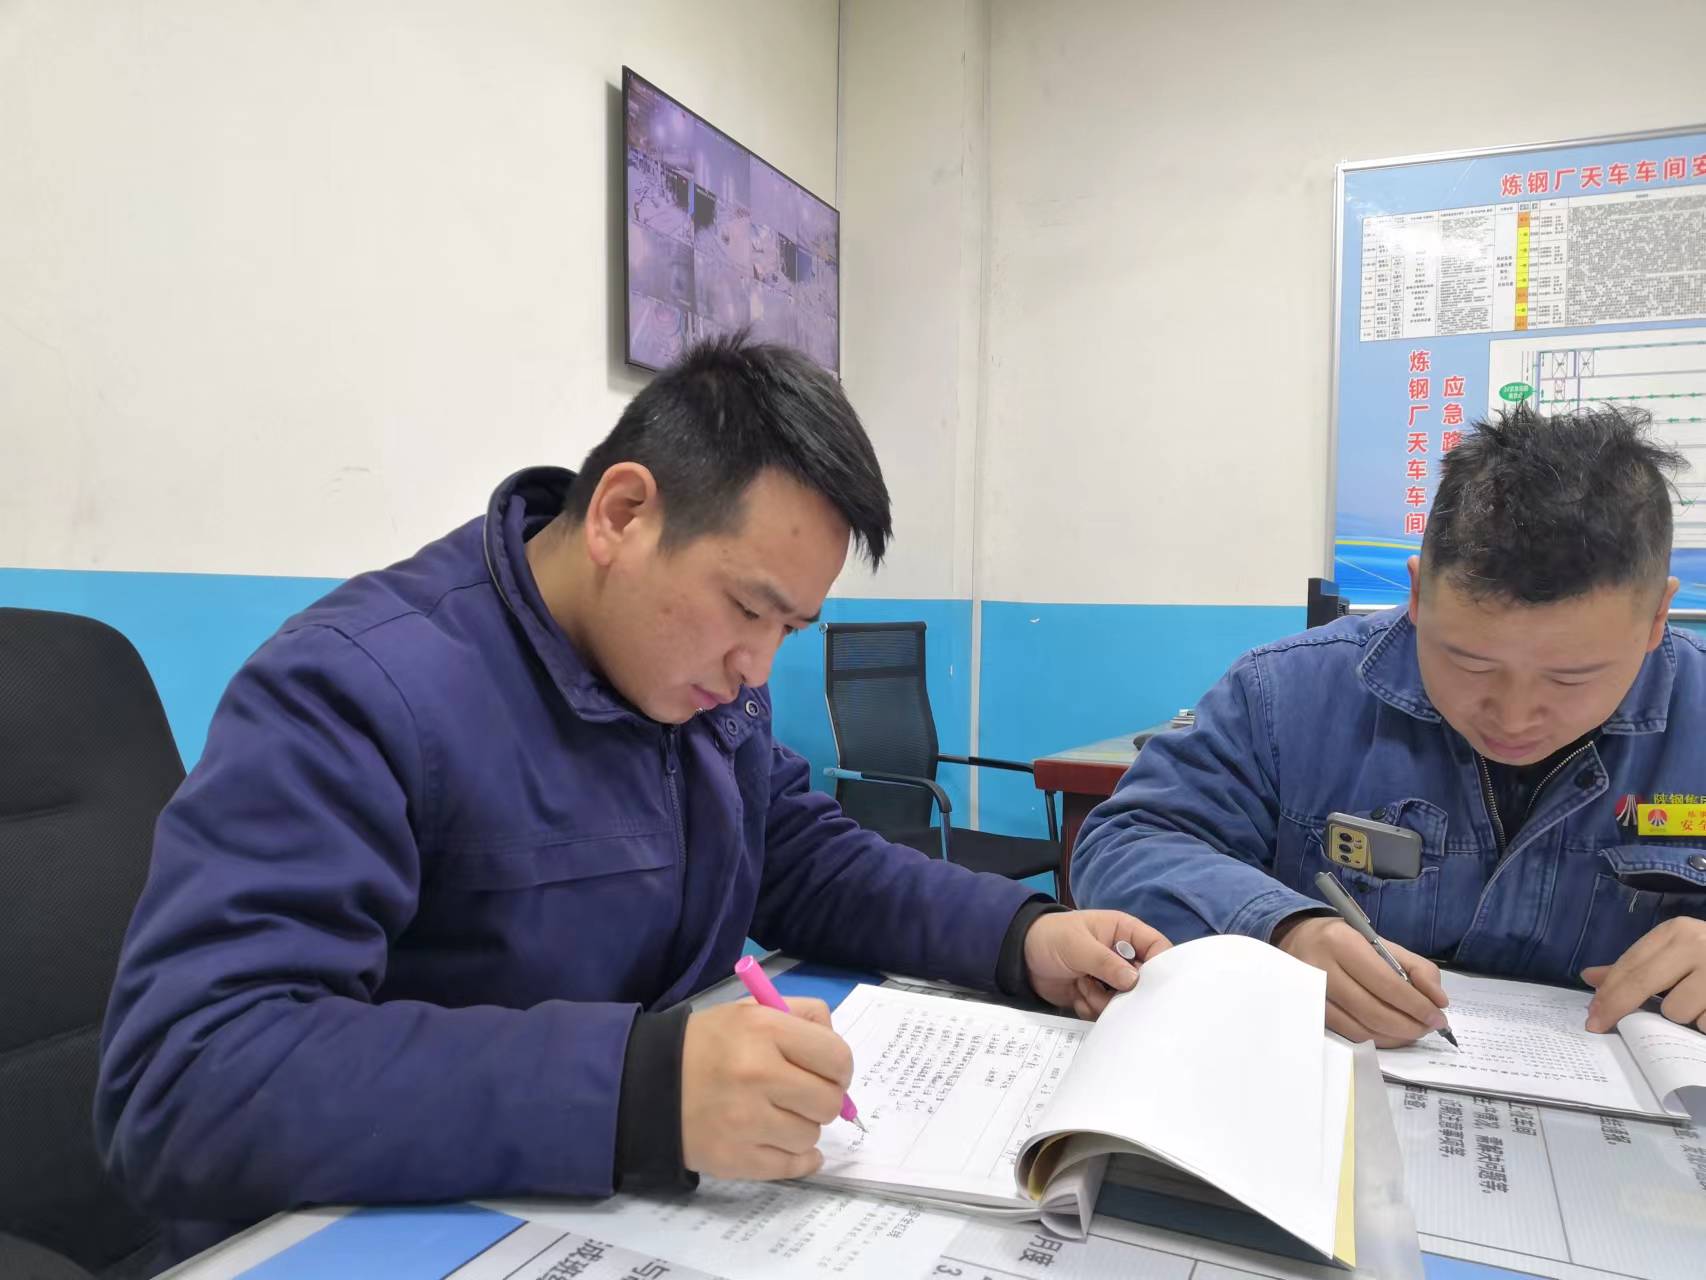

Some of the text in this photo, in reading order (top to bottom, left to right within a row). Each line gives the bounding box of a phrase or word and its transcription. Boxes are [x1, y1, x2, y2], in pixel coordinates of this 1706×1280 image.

[1405, 350, 1431, 534] 炼钢厂天车车间
[1440, 376, 1465, 464] 应急路
[1018, 1233, 1064, 1268] 月度
